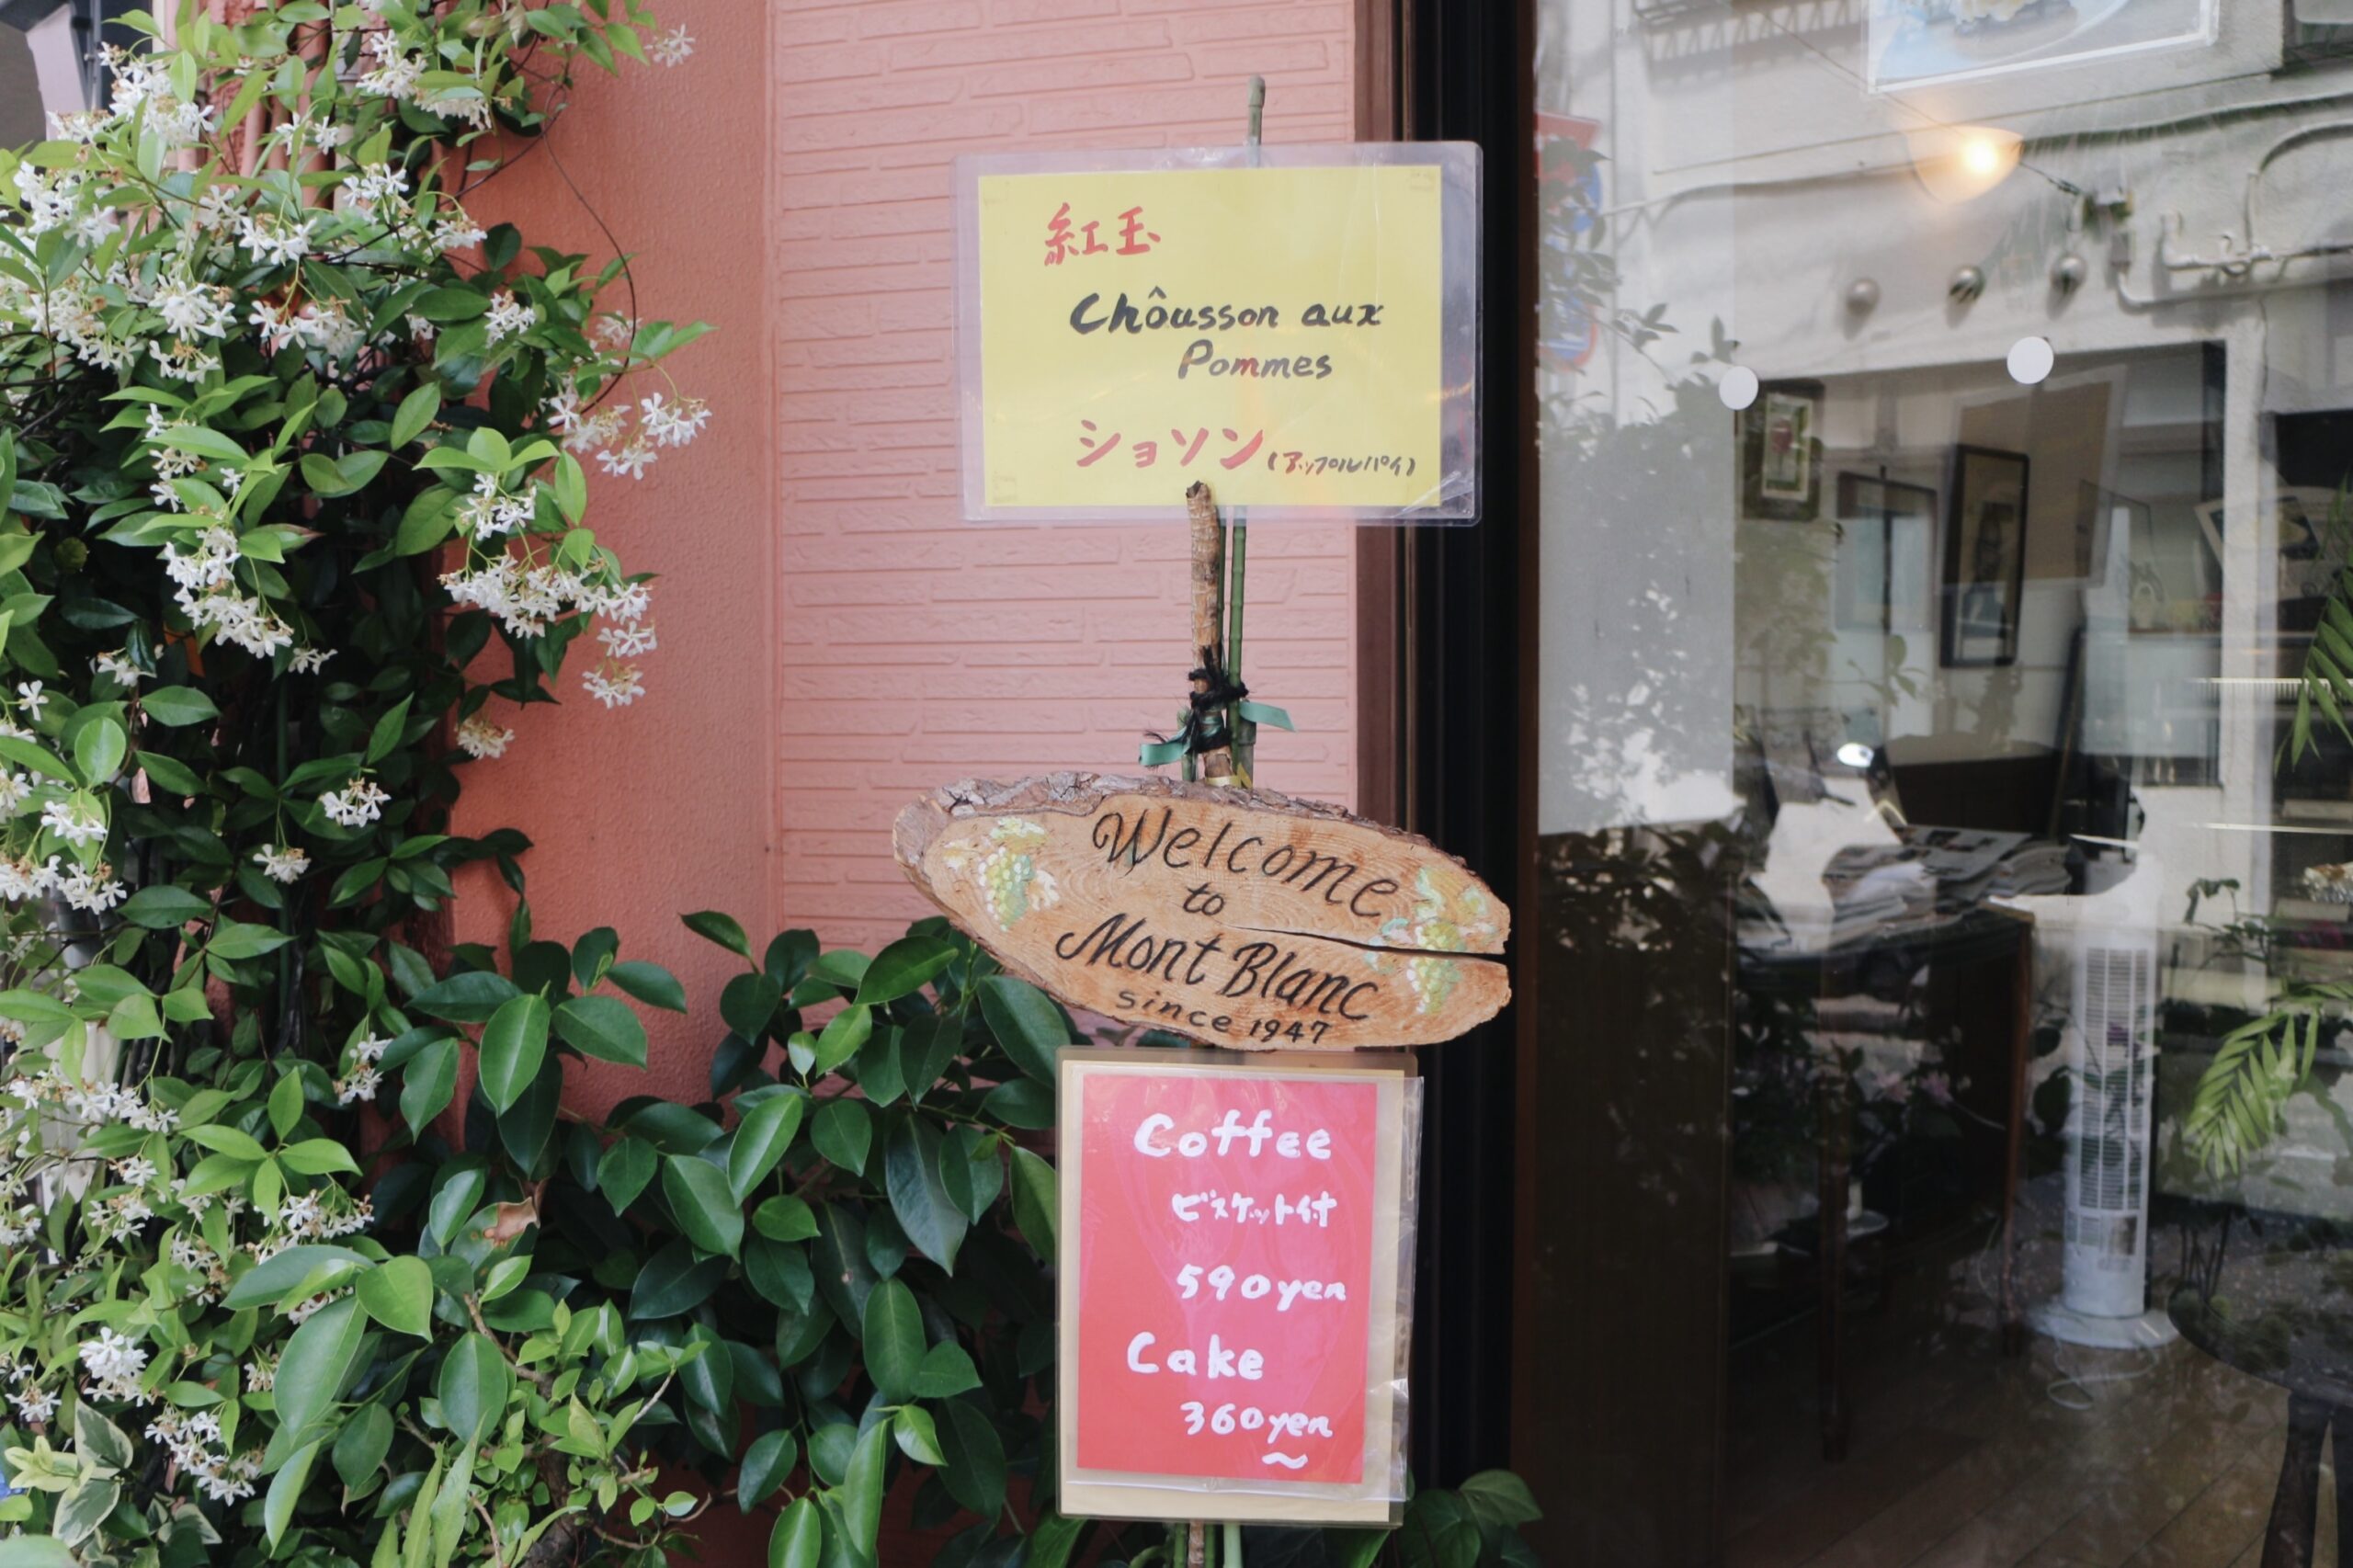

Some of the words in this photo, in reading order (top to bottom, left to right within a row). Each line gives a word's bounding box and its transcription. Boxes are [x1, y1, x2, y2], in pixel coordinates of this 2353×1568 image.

[1044, 202, 1161, 266] 紅玉
[1302, 301, 1384, 328] aux
[1177, 338, 1333, 380] Pommes
[1092, 807, 1400, 918] Welcome
[1182, 882, 1225, 917] to
[1056, 913, 1222, 987] Mont
[1224, 940, 1379, 1022] Blanc
[1248, 1017, 1332, 1044] 1947
[1133, 1108, 1333, 1161] Coffee
[1171, 1189, 1338, 1228] ビスケット付
[1127, 1331, 1265, 1381] Cake
